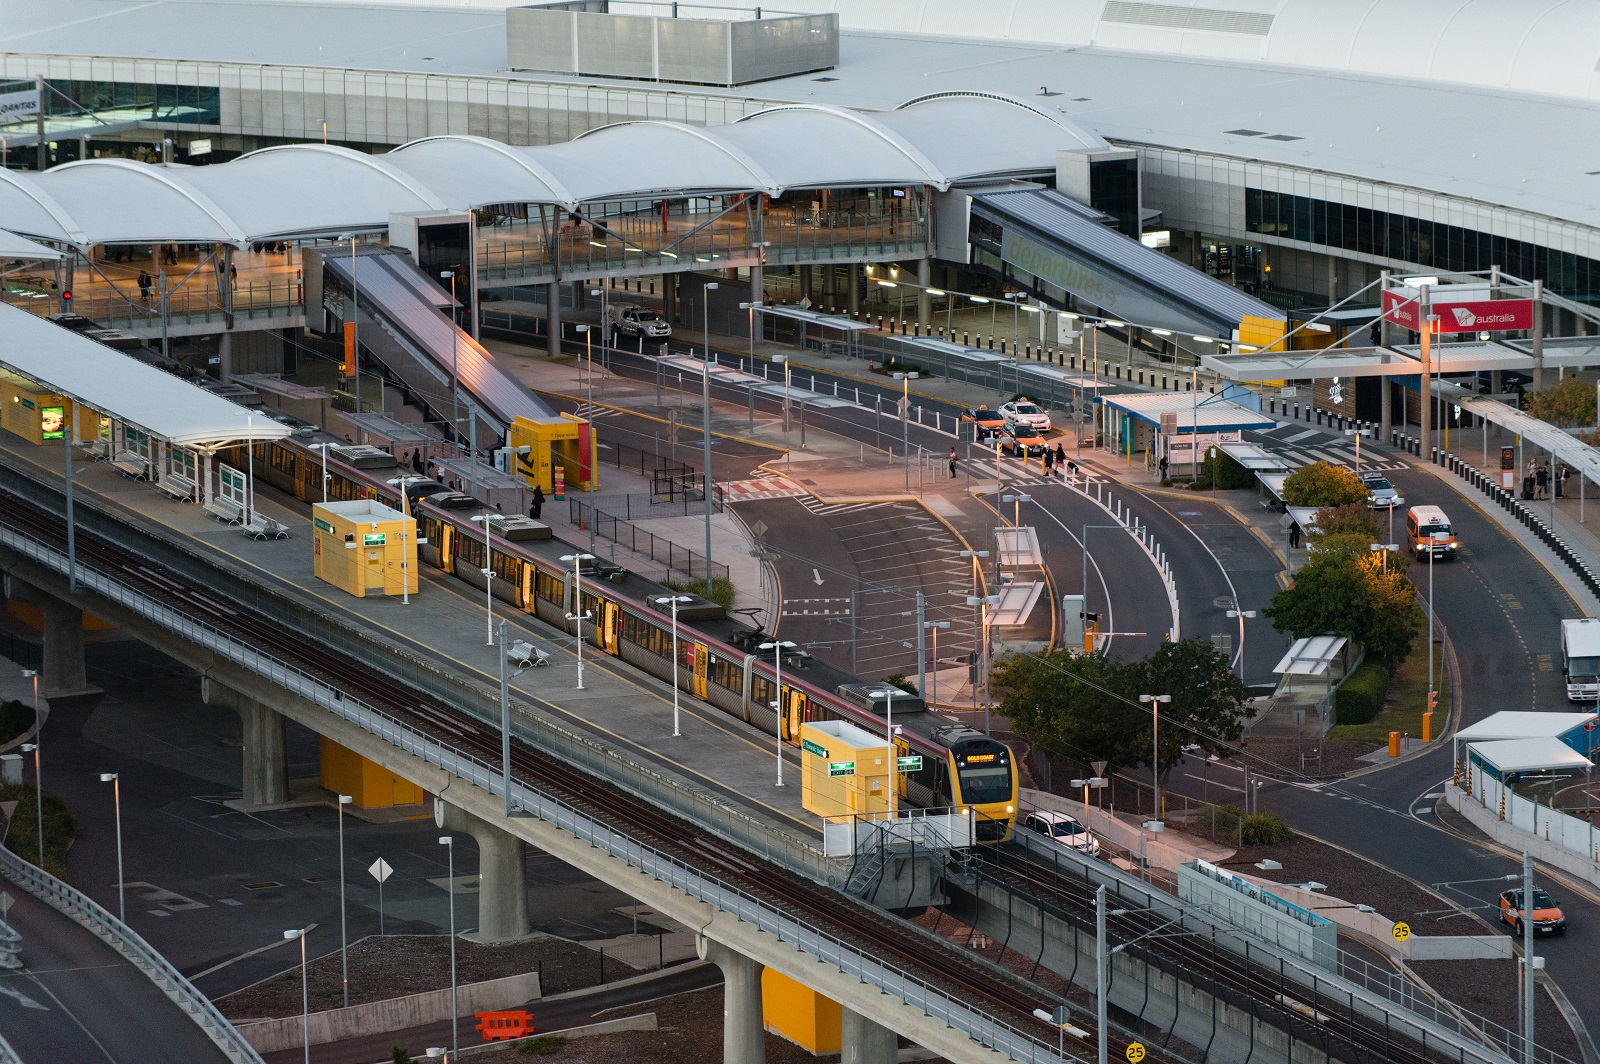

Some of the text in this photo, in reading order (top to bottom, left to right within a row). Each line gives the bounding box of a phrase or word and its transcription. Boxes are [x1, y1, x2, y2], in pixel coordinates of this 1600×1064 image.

[1009, 237, 1105, 301] departures
[1476, 313, 1515, 323] australia
[1395, 926, 1408, 937] 25
[1128, 1047, 1143, 1058] 25
